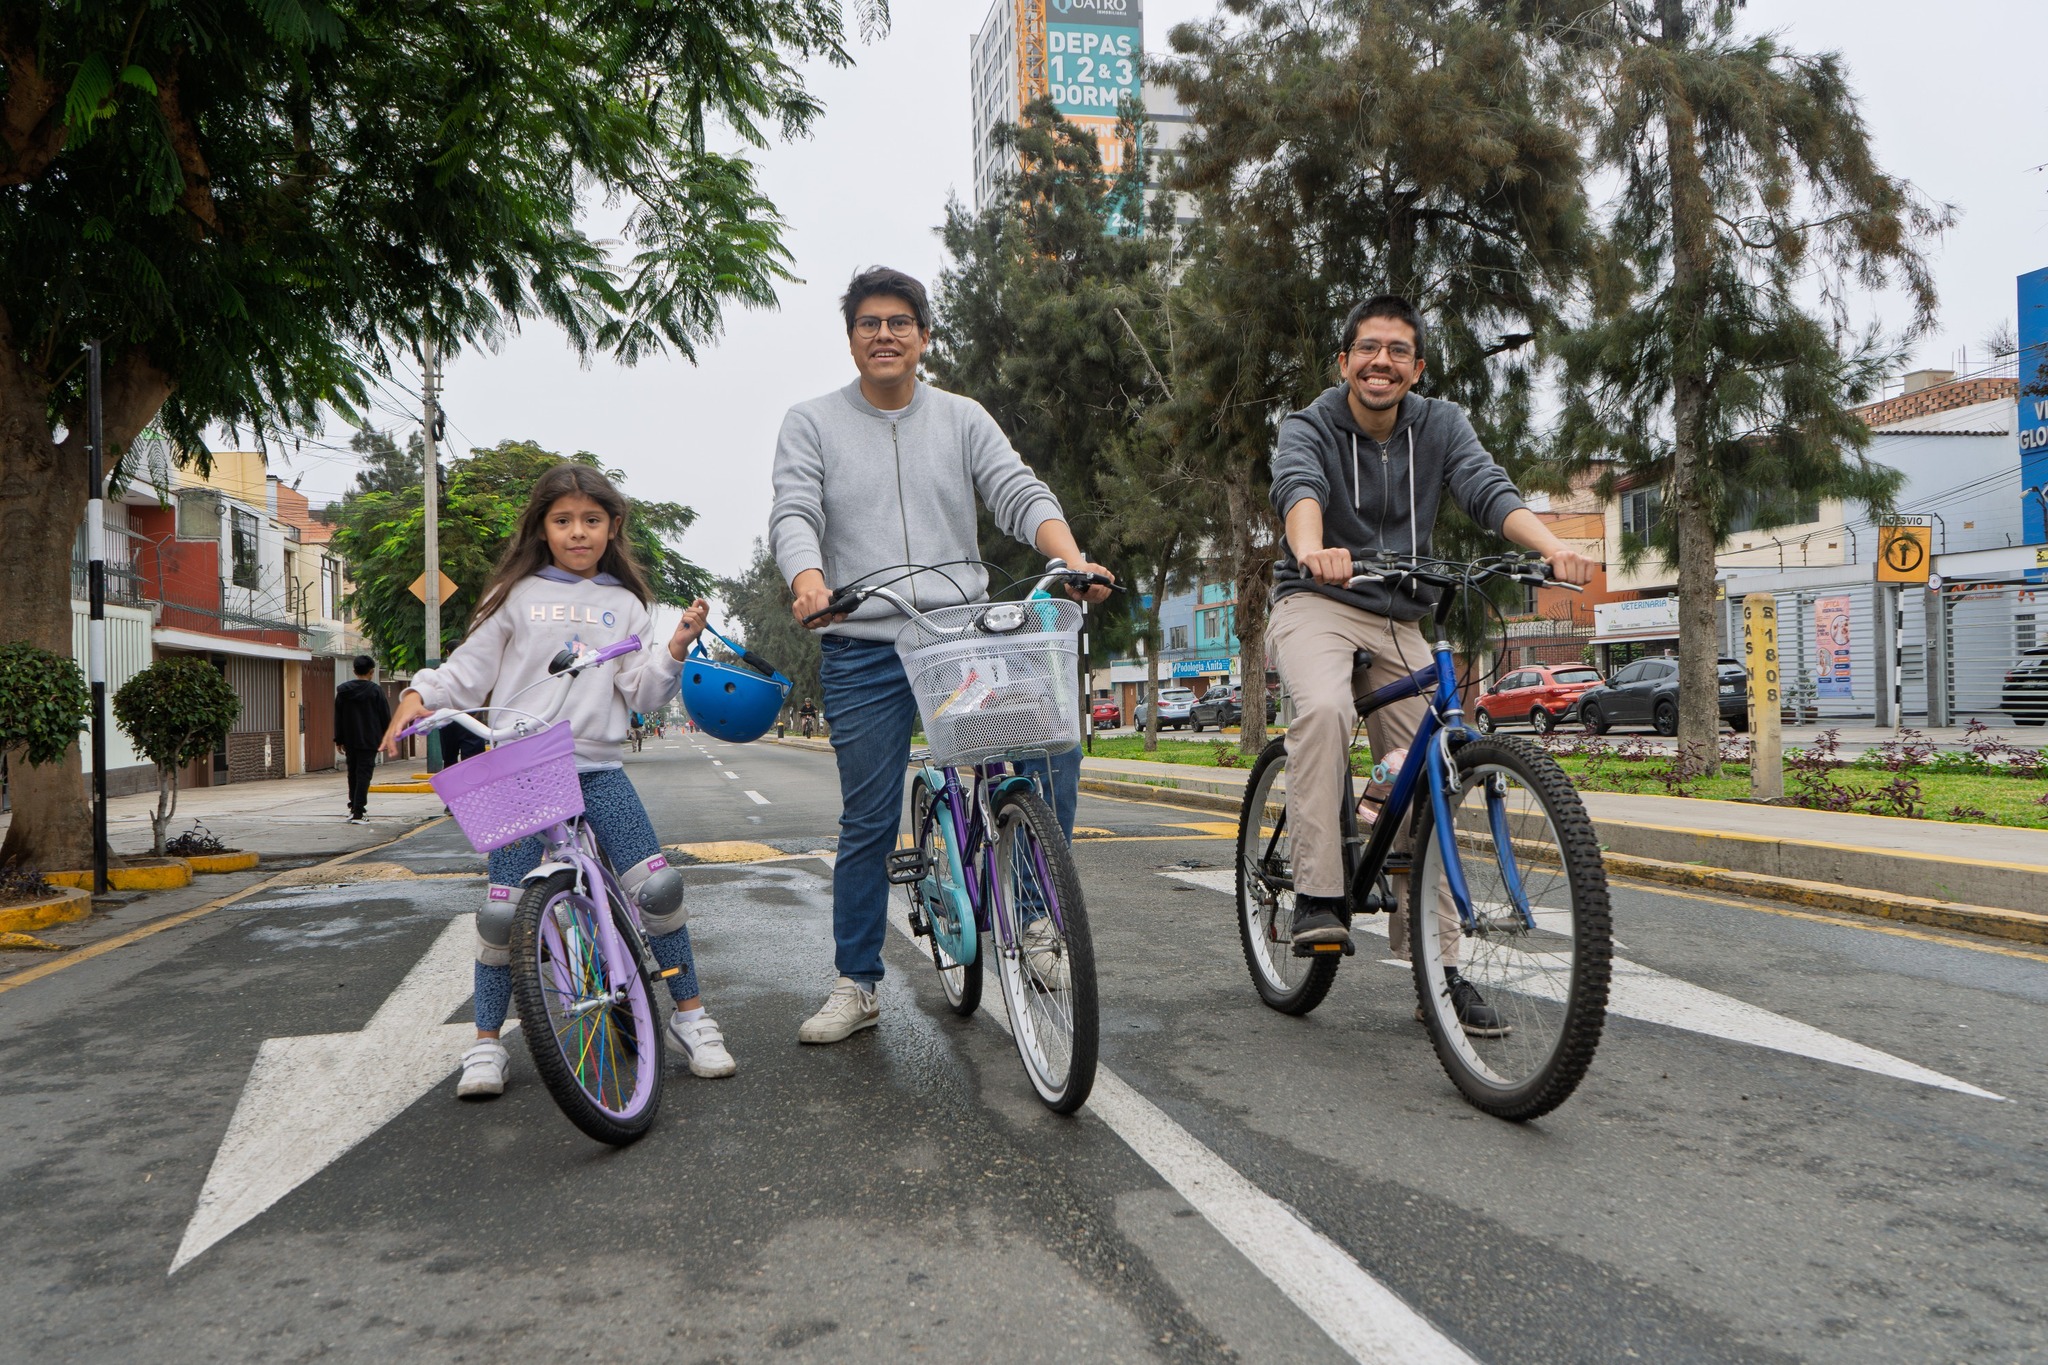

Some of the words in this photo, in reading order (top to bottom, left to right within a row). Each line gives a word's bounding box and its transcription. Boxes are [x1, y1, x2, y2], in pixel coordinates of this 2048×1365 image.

[1049, 31, 1132, 56] DEPAS
[1115, 59, 1133, 85] 3
[2020, 426, 2048, 450] GLO
[1888, 516, 1923, 525] DESVIO
[530, 605, 616, 627] HELLO
[1621, 600, 1667, 610] VETERINARIA
[1744, 606, 1754, 655] GAS
[1765, 629, 1778, 702] 1808
[1746, 667, 1759, 787] NATURAL
